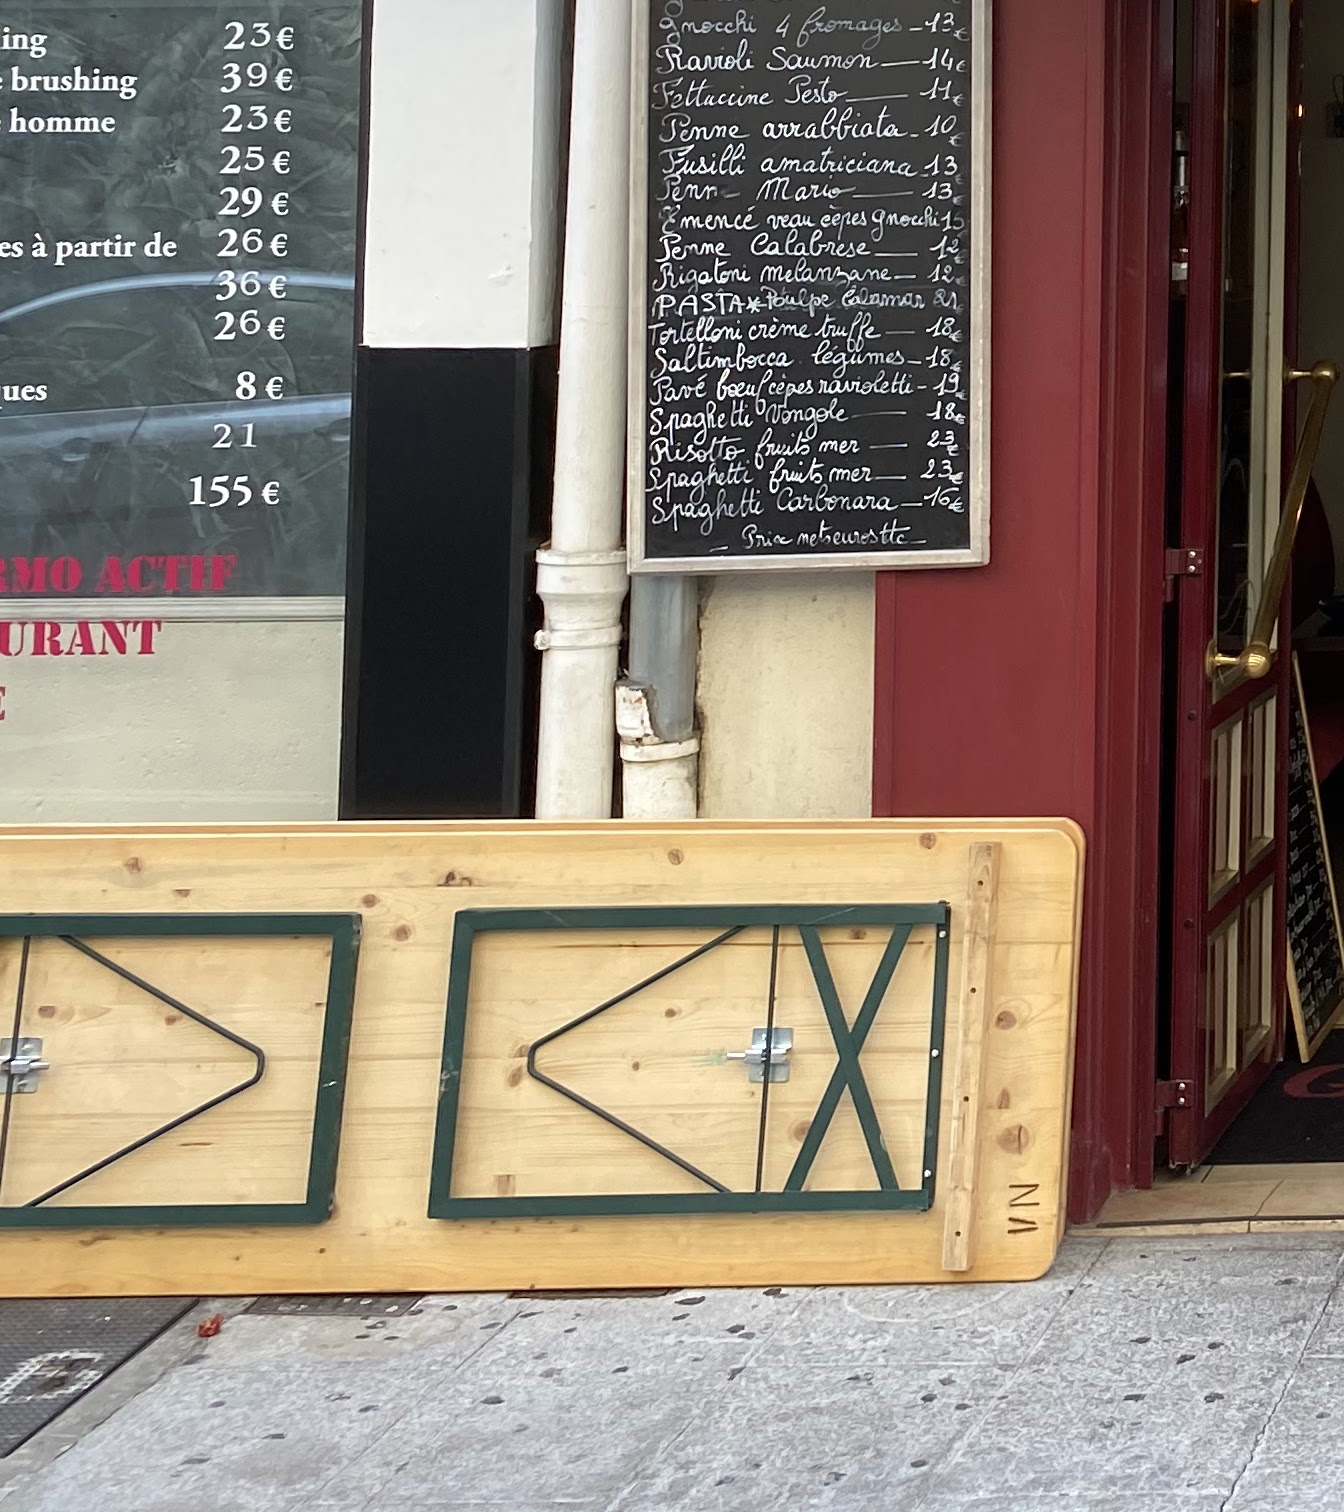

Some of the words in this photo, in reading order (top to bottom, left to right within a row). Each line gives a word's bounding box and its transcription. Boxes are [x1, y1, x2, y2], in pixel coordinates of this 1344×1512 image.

[775, 13, 790, 38] 4
[797, 7, 903, 49] fromages
[656, 39, 755, 74] Ravioli
[766, 46, 879, 71] Saumon
[11, 65, 139, 100] brushing
[785, 74, 849, 105] Pesto
[9, 106, 116, 133] homme
[658, 112, 750, 142] Penne
[762, 105, 907, 140] arrabbiata
[658, 143, 746, 175] Fusilli
[760, 146, 917, 178] amatriciana
[756, 175, 856, 201] Mario
[766, 210, 817, 229] veau
[31, 232, 48, 258] à
[53, 234, 137, 266] partir
[144, 231, 178, 258] de
[654, 233, 731, 262] Penne
[750, 229, 871, 258] Calabrese
[652, 258, 751, 293] Rigatoni
[748, 318, 811, 339] crème
[815, 312, 881, 353] truffe
[651, 345, 795, 378] Saltimbocca
[0, 383, 48, 409] ues
[650, 373, 707, 406] Pavé
[213, 423, 257, 449] 21
[650, 400, 753, 445] Spaghetti
[650, 436, 746, 465] Risotto
[755, 427, 810, 469] fruits
[818, 438, 859, 454] mer
[645, 460, 755, 504] Spaghetti
[769, 457, 824, 493] fruits
[829, 467, 874, 484] mer
[651, 489, 764, 535] Spaghetti
[776, 484, 899, 512] Carbonara
[0, 556, 82, 593] MO
[95, 554, 238, 593] ACTIF
